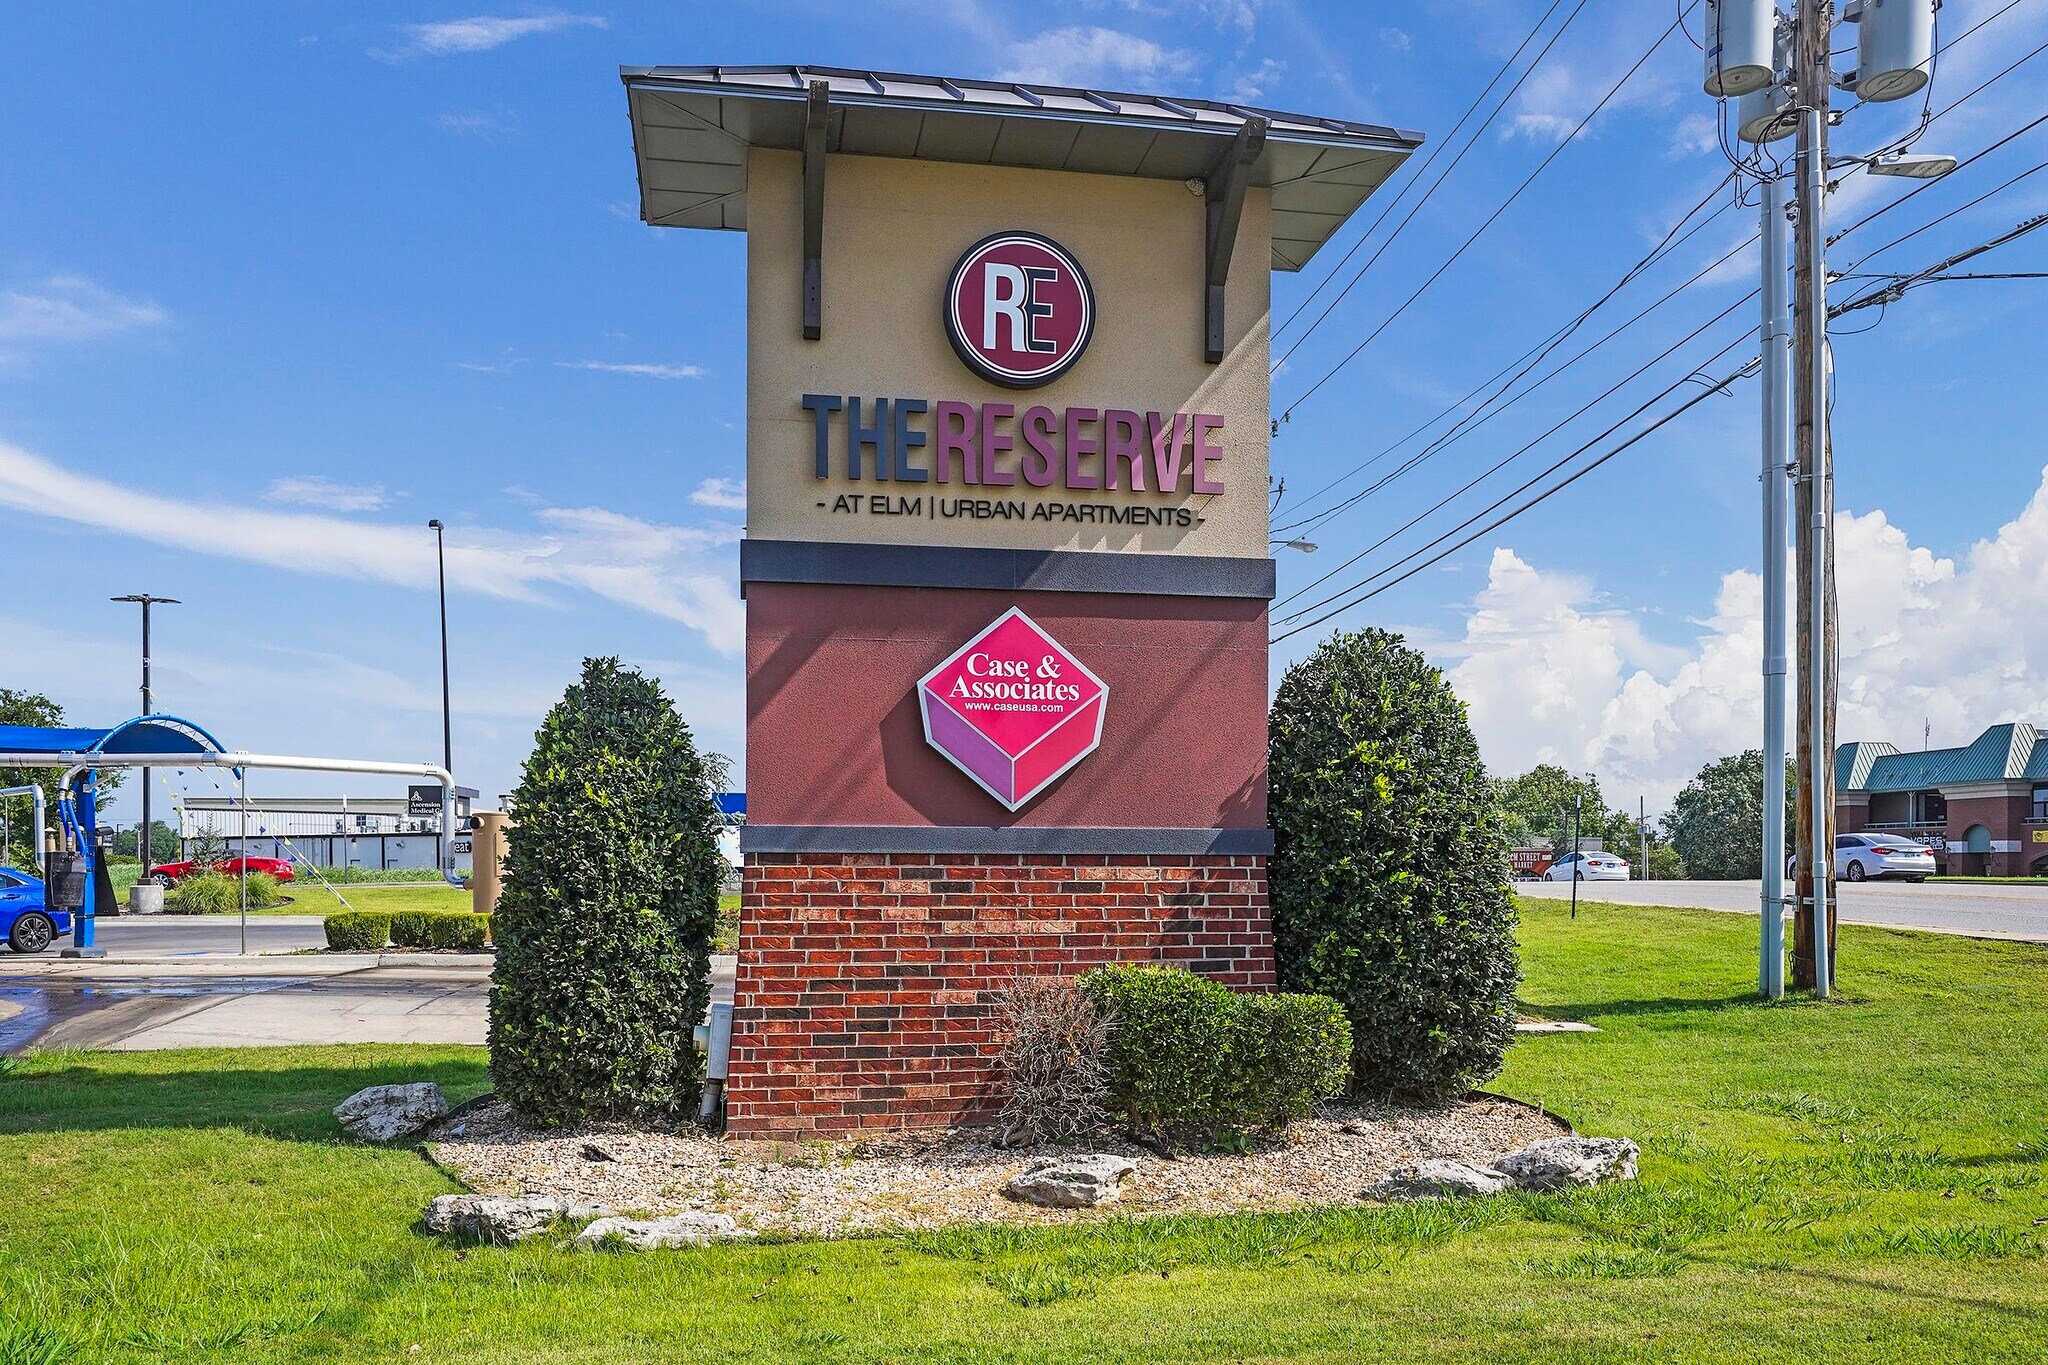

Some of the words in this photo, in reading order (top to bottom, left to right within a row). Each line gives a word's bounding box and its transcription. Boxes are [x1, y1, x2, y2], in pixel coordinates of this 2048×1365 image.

[983, 261, 1059, 355] RE
[833, 494, 865, 514] AT
[871, 495, 922, 517] ELM
[941, 498, 1026, 520] URBAN
[1031, 502, 1192, 527] APARTMENTS
[966, 652, 1029, 678] Case
[1036, 655, 1062, 679] &
[949, 675, 1081, 702] Associates
[964, 701, 1064, 713] www.caseusa.com
[1519, 852, 1540, 861] STREET
